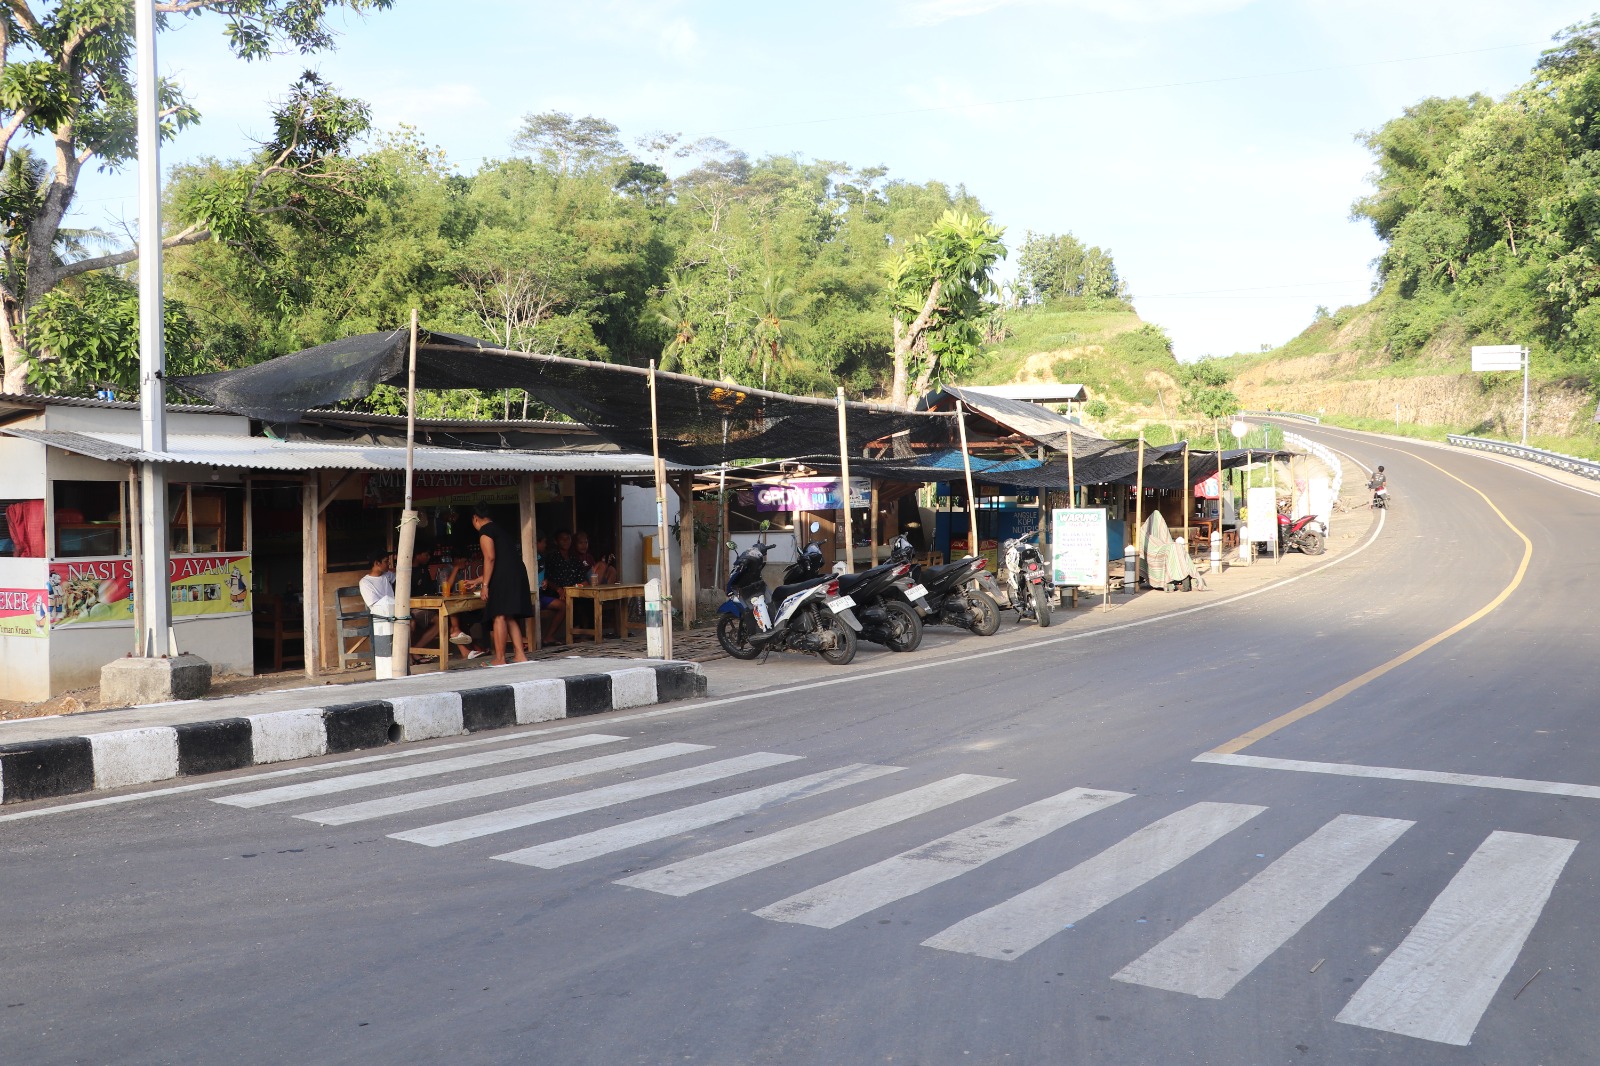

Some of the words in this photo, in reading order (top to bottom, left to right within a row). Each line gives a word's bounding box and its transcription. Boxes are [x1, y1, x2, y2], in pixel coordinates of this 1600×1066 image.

[416, 473, 464, 488] AYAM
[468, 473, 518, 487] CEKER
[811, 492, 835, 504] BOLD
[67, 562, 116, 580] NASI
[181, 558, 230, 576] AYAM
